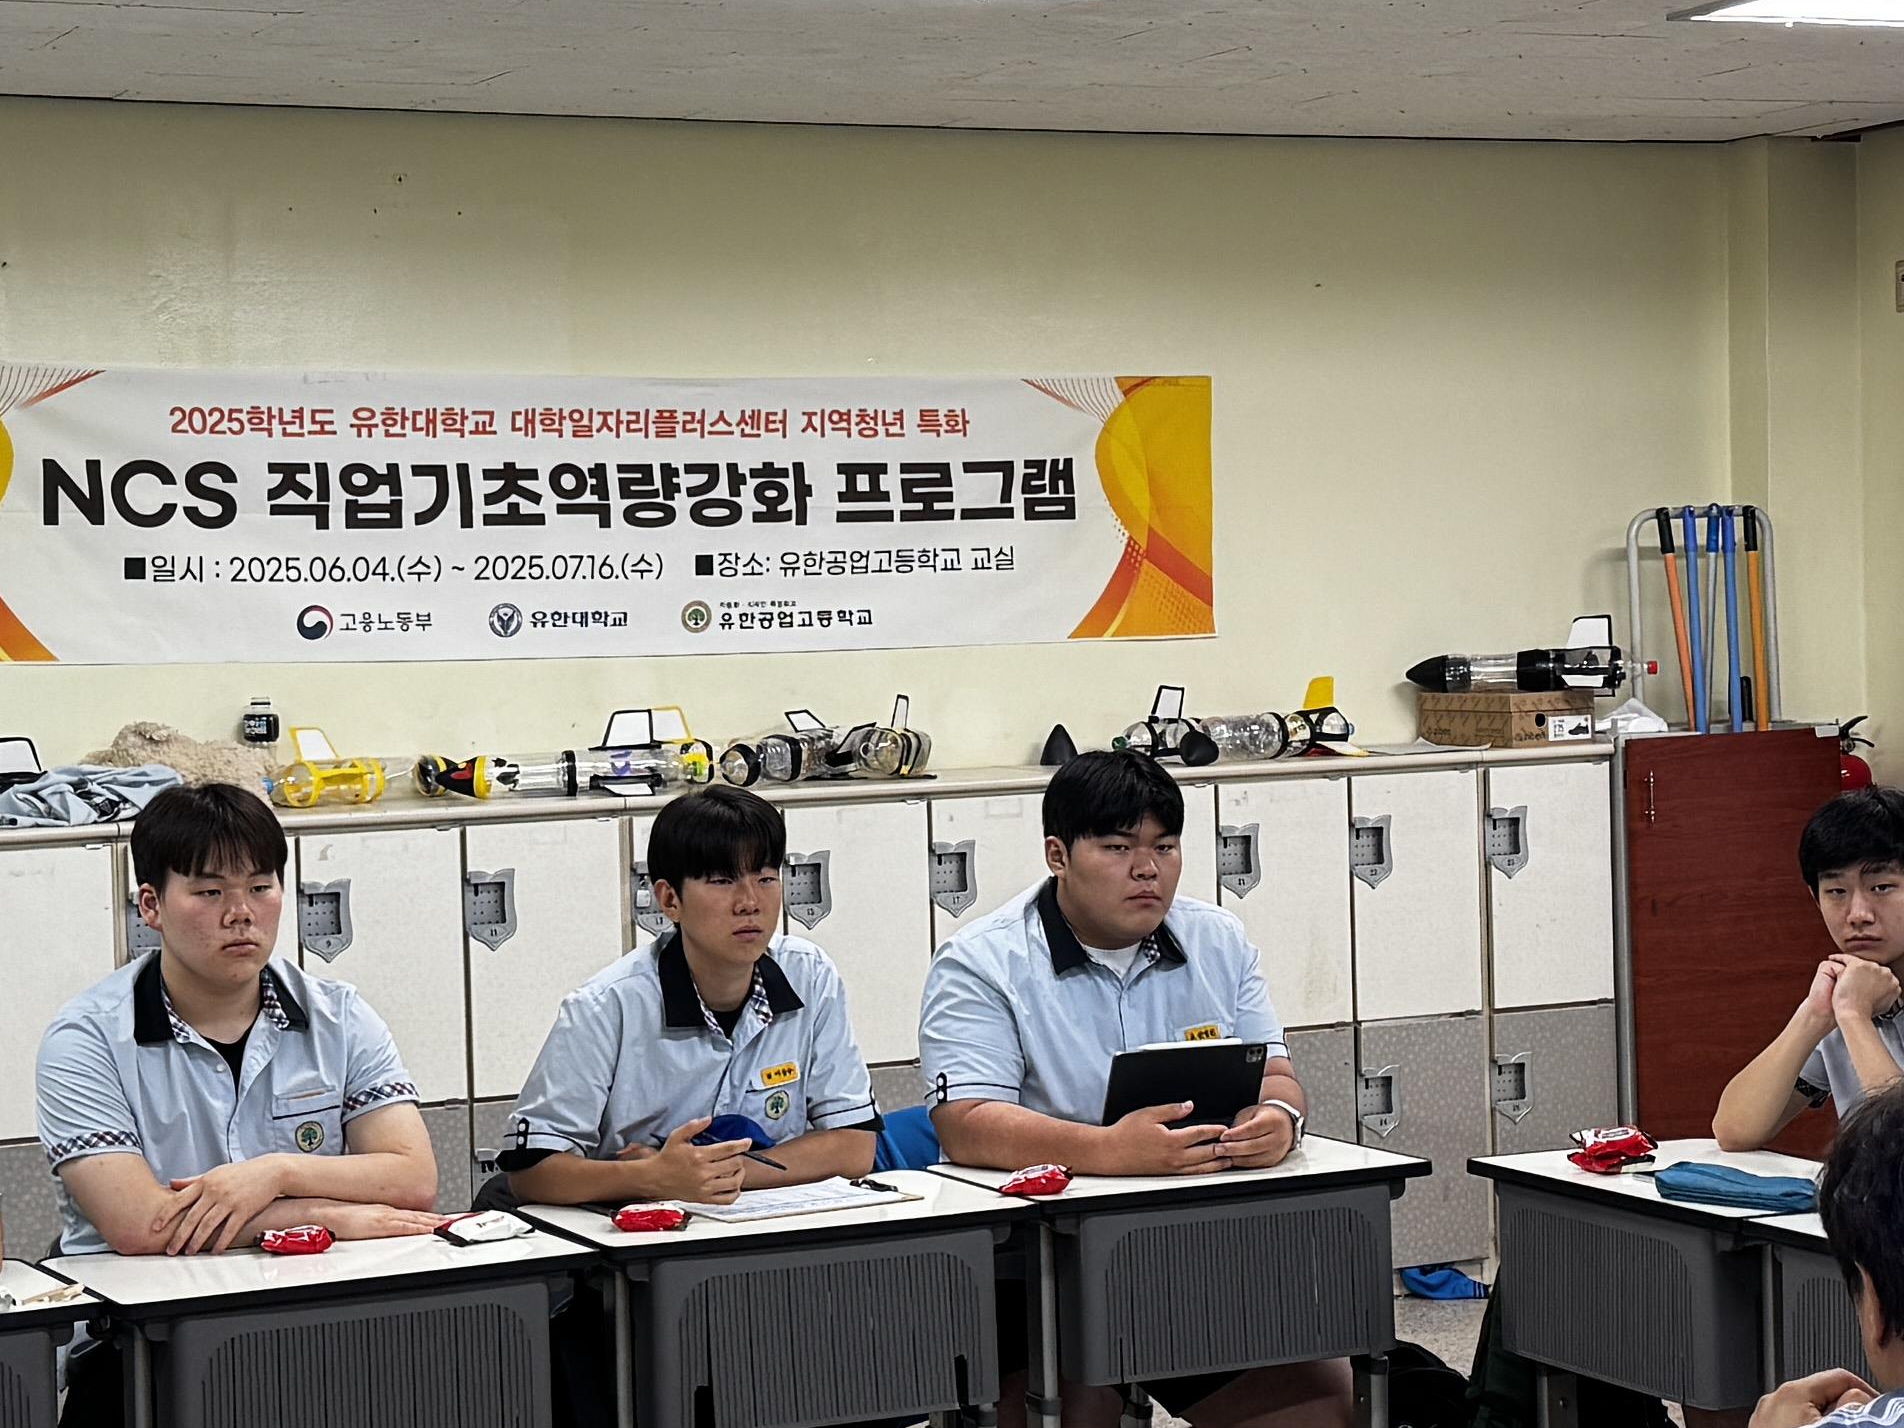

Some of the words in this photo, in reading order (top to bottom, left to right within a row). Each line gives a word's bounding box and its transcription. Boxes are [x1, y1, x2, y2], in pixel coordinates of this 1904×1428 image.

[169, 406, 337, 438] 2025학년도
[350, 407, 497, 438] 유한대학교
[511, 408, 787, 439] 대학일자리플러스센터
[801, 408, 905, 438] 지역청년
[917, 408, 970, 437] 특화
[42, 459, 238, 529] NCS
[267, 462, 812, 530] 직업기초역량강화
[836, 458, 1076, 523] 프로그램
[151, 556, 203, 582] 일시
[230, 555, 441, 582] 2025.06.04.(수)
[474, 553, 663, 580] 2025.07.16.(수)
[718, 552, 770, 577] 장소:
[779, 548, 962, 577] 유한공업고등학교
[971, 546, 1014, 570] 교실
[339, 612, 432, 633] 고용노동부
[530, 611, 627, 628] 유한대학교
[719, 610, 873, 630] 유한공업고등학교
